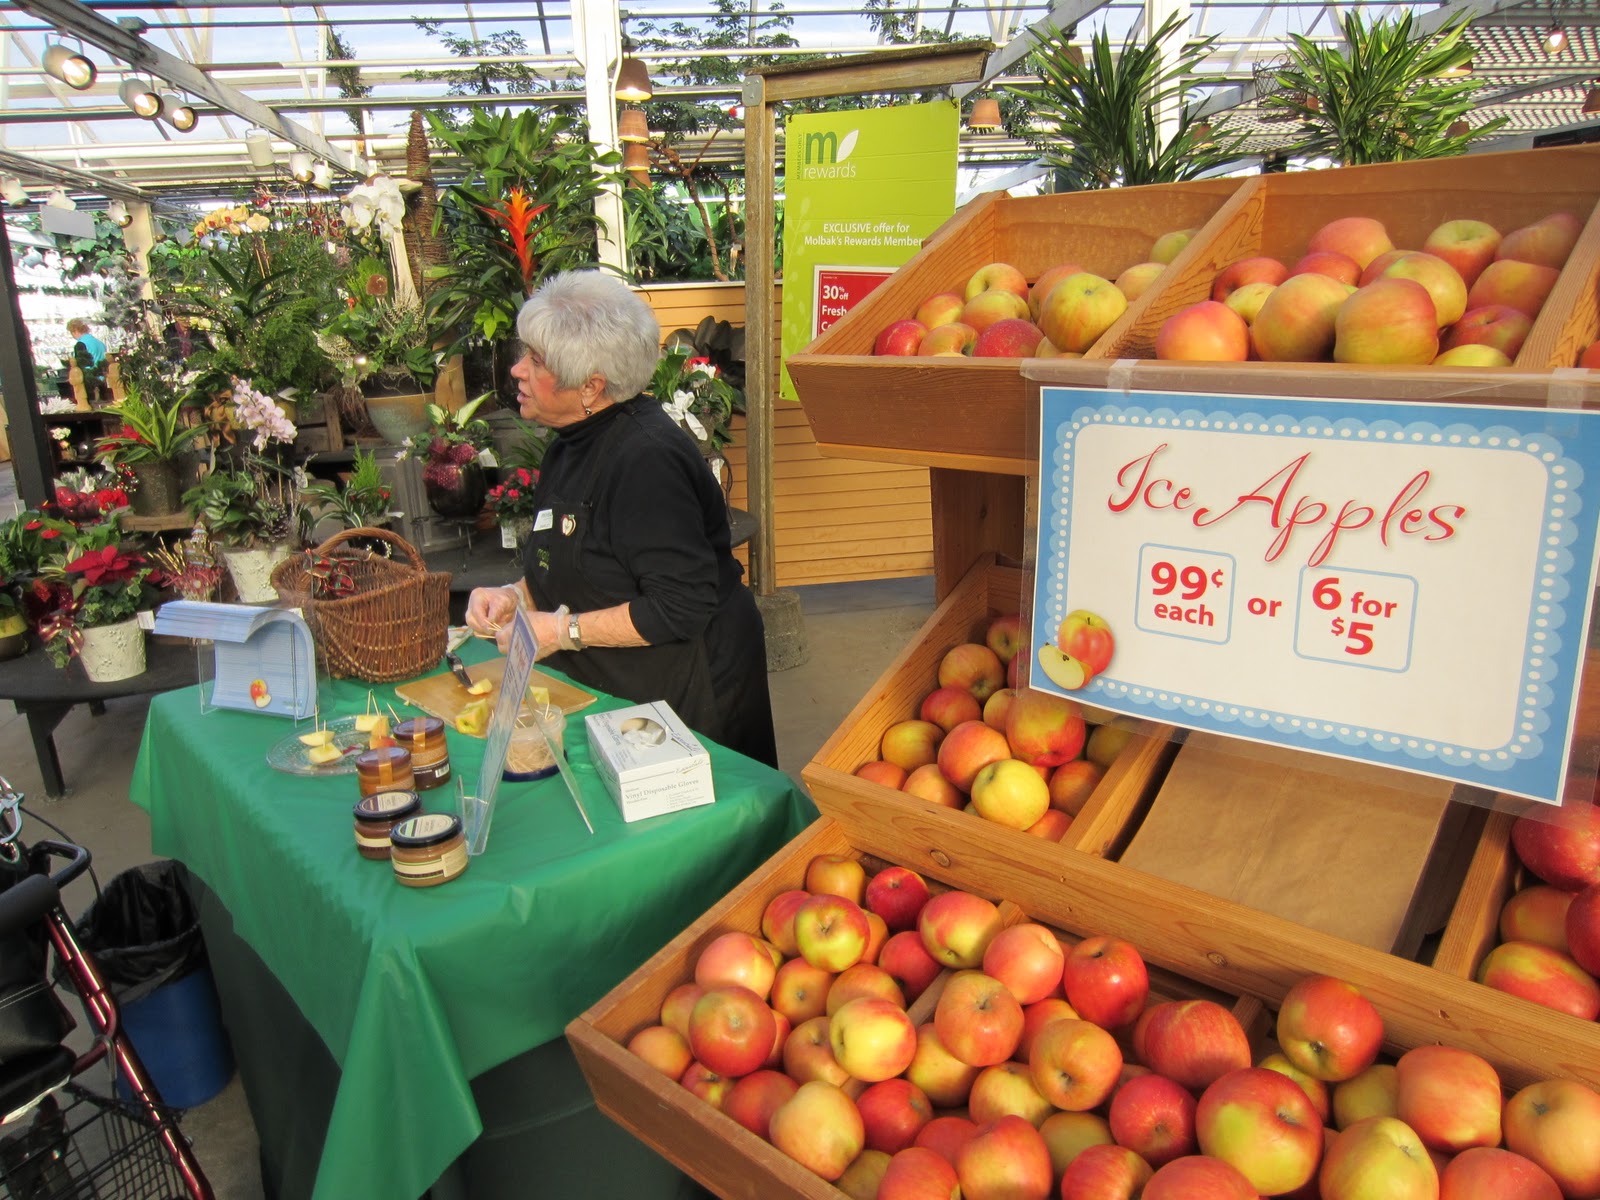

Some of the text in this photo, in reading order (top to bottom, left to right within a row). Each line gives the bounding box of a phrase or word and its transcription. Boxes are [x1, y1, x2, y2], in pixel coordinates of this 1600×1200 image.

[804, 162, 856, 179] rewards
[823, 222, 910, 233] EXCLUSIVE offer for
[804, 235, 925, 247] Molbak's Rewards Member
[821, 305, 847, 316] Fresh
[1107, 442, 1466, 568] Ice Apples
[1151, 561, 1223, 600] 99¢
[1247, 597, 1282, 617] or
[1312, 577, 1397, 618] 6 for
[1153, 603, 1214, 626] each
[1331, 616, 1374, 655] $5
[625, 790, 643, 800] Vinyl
[643, 783, 677, 797] Disposable
[678, 778, 699, 788] Gloves
